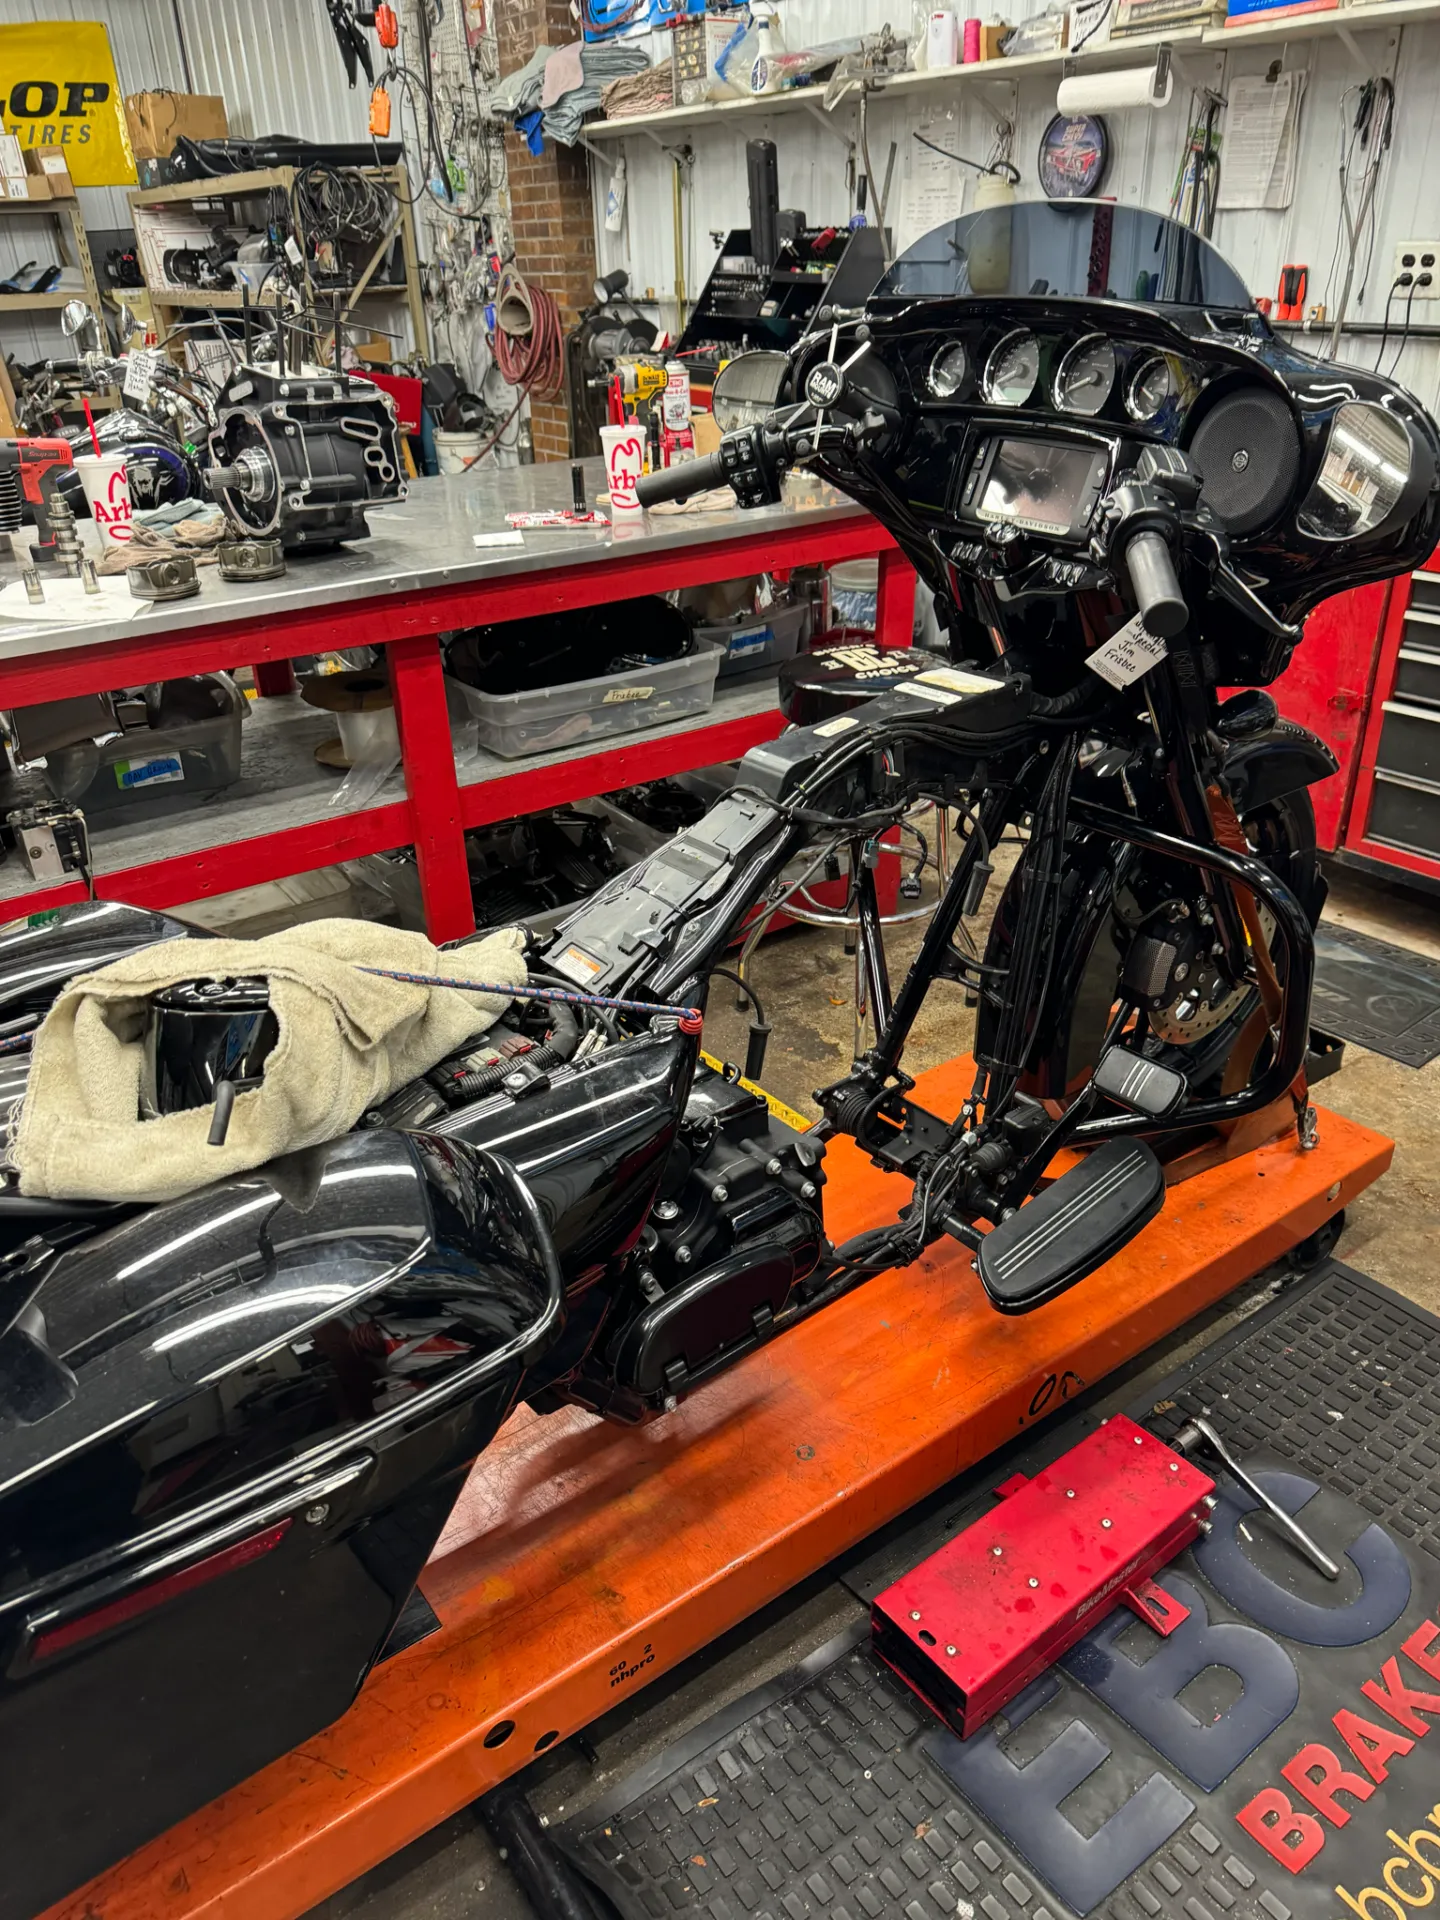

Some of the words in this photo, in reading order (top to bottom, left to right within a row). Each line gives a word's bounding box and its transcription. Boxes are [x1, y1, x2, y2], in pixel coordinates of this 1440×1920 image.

[10, 124, 92, 145] TIRES
[607, 469, 641, 490] rb
[1118, 640, 1135, 658] Jim
[1104, 648, 1137, 673] Frisbee
[854, 664, 920, 680] CHOICE
[1076, 1555, 1143, 1621] BikeMaster
[643, 1643, 653, 1655] 2
[609, 1660, 627, 1677] 60
[610, 1653, 656, 1688] nhpro
[922, 1471, 1412, 1918] EBC
[1236, 1603, 1440, 1875] BRAKE
